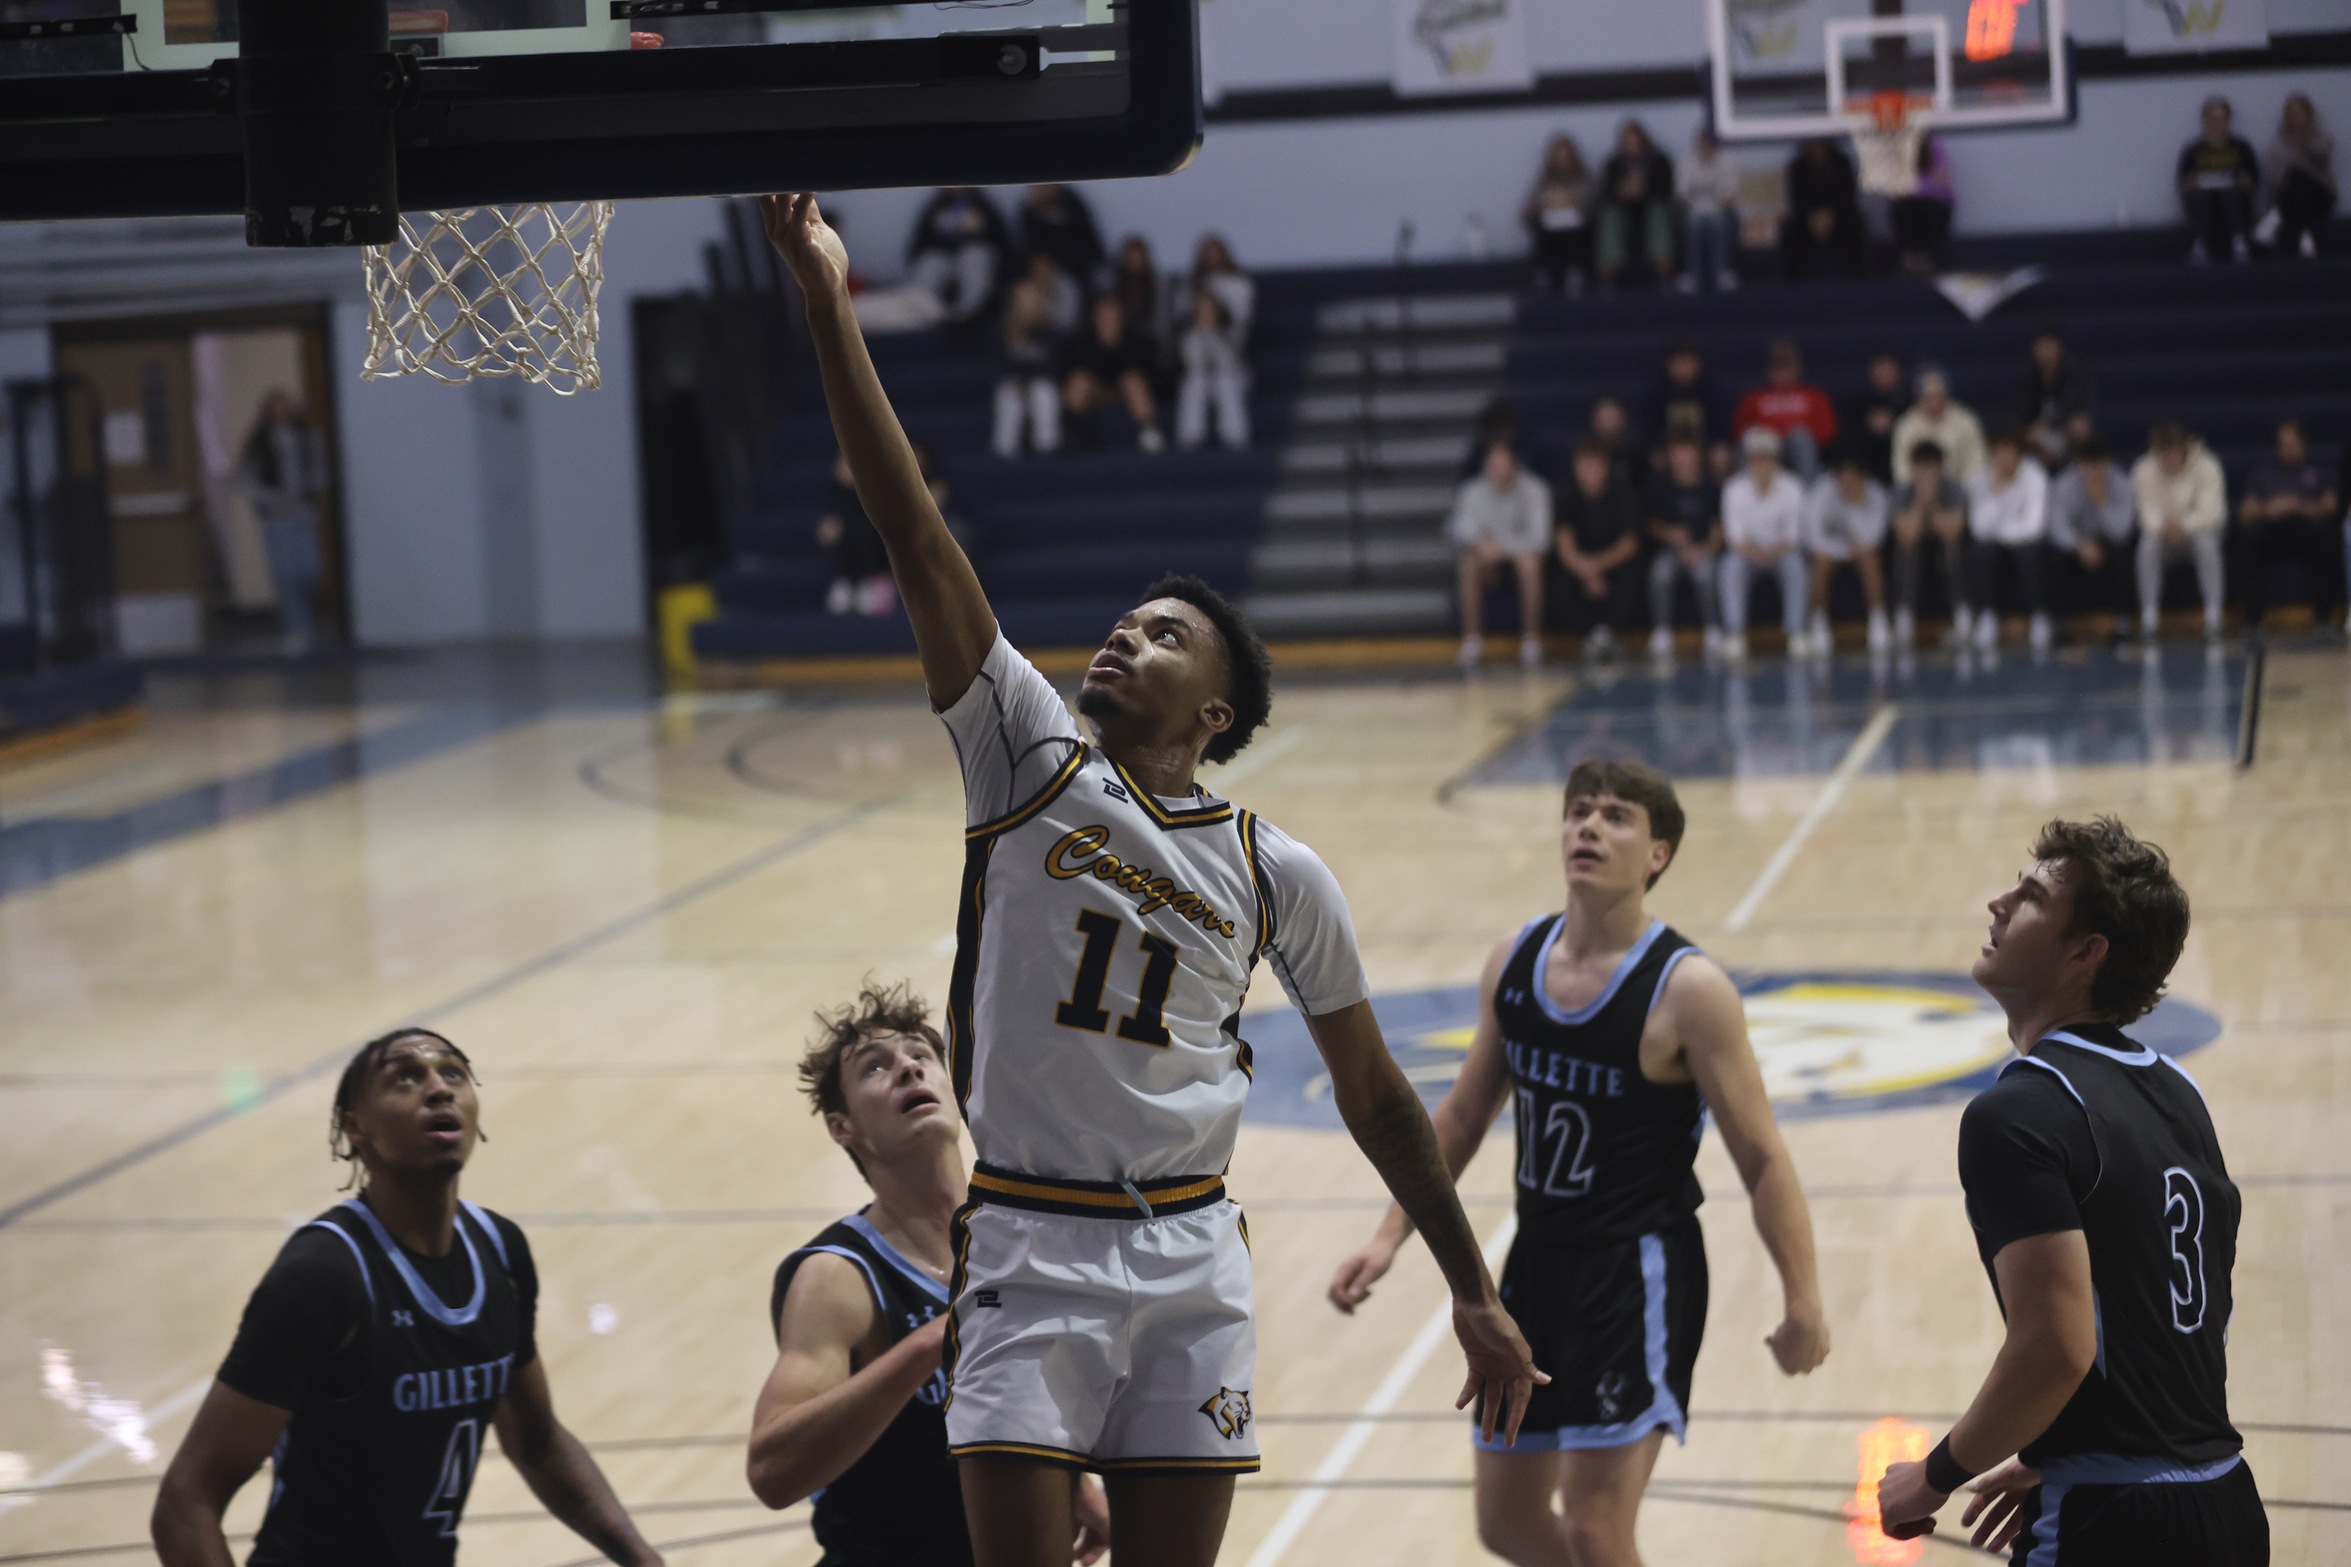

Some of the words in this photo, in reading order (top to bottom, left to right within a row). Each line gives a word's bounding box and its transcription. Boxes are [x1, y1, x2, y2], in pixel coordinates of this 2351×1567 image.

[1044, 824, 1236, 939] Cougars
[1055, 907, 1181, 1050] 11
[1502, 1036, 1625, 1097] ILLETTE
[1516, 1084, 1596, 1197] 12
[2163, 1166, 2207, 1335] 3
[393, 1352, 515, 1412] GILLETT
[421, 1416, 478, 1539] 4
